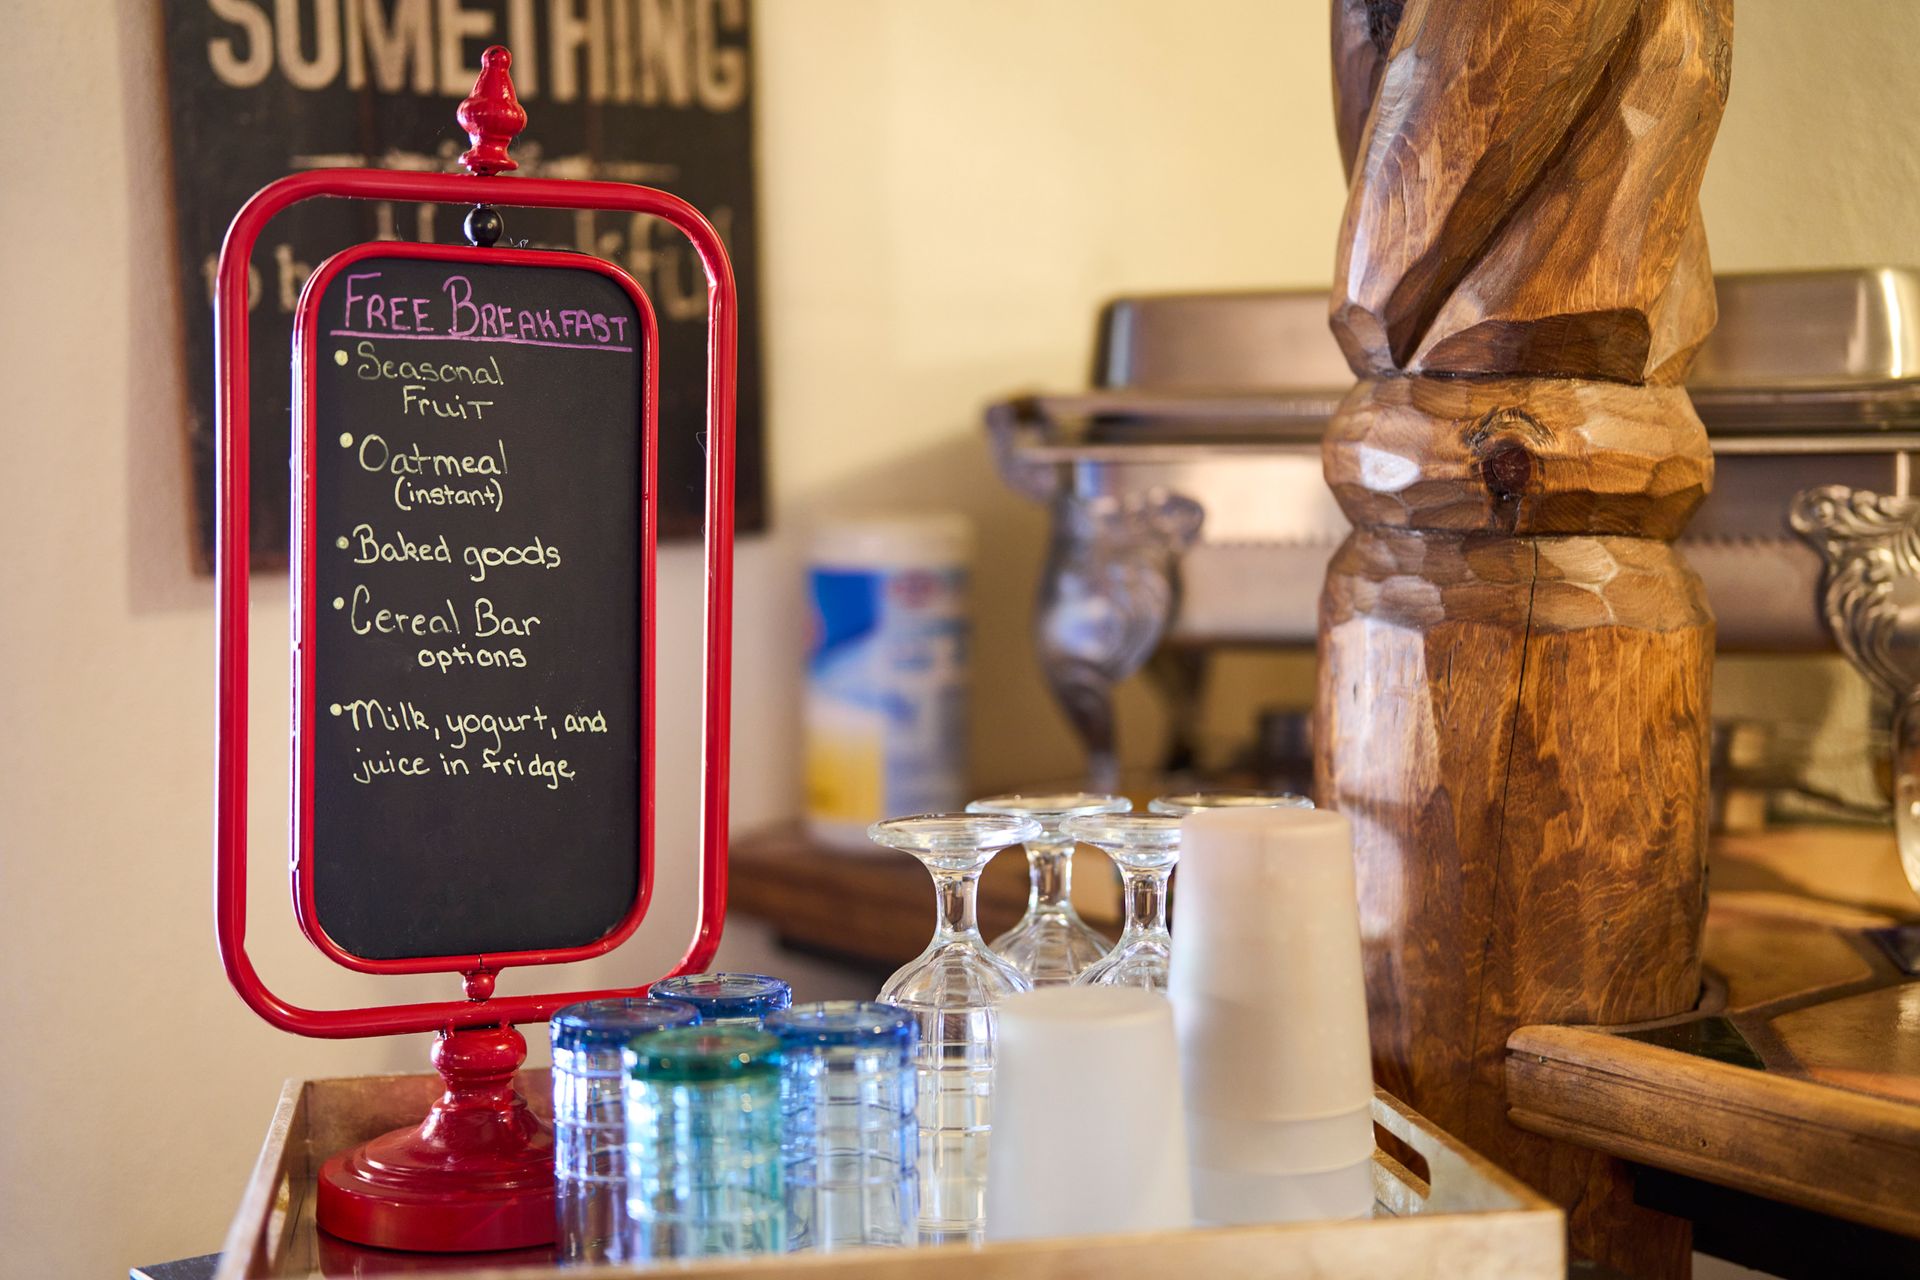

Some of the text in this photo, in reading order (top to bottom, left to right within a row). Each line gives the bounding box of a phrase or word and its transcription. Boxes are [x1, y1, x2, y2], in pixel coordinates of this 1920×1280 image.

[344, 272, 435, 332] FREE
[442, 275, 629, 342] BREAKFAST
[357, 340, 504, 386] Seasonal
[358, 434, 508, 477] Oatmeal
[394, 475, 504, 512] (instant)
[352, 523, 562, 583] Baked goods
[351, 584, 541, 637] Cereal Bar
[417, 644, 528, 674] options
[343, 699, 608, 753] Milk, yogurt, and
[353, 747, 431, 784] juice
[439, 752, 470, 776] in
